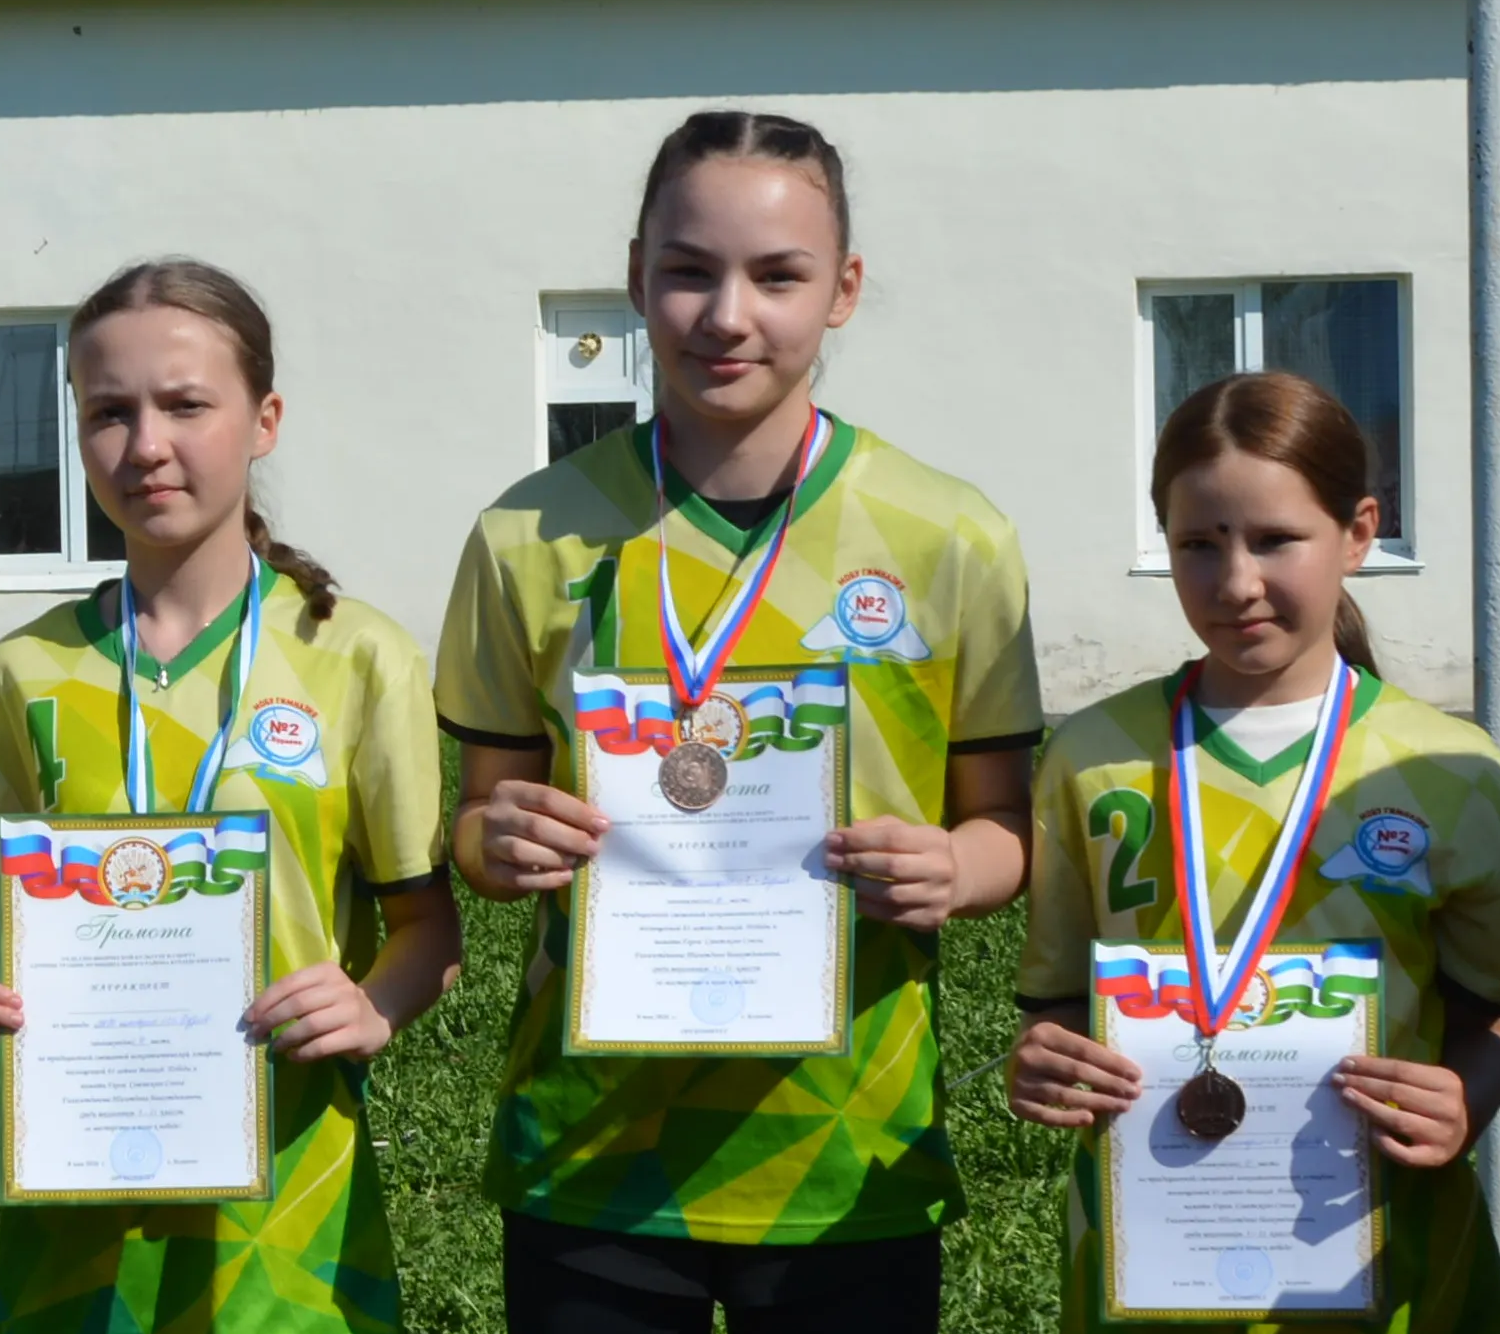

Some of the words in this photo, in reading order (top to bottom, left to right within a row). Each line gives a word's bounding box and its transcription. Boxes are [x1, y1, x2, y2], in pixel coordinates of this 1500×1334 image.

[855, 595, 887, 613] №2
[269, 720, 300, 736] №2
[1377, 830, 1410, 845] №2
[1089, 788, 1157, 915] 2
[74, 914, 193, 949] Грамота
